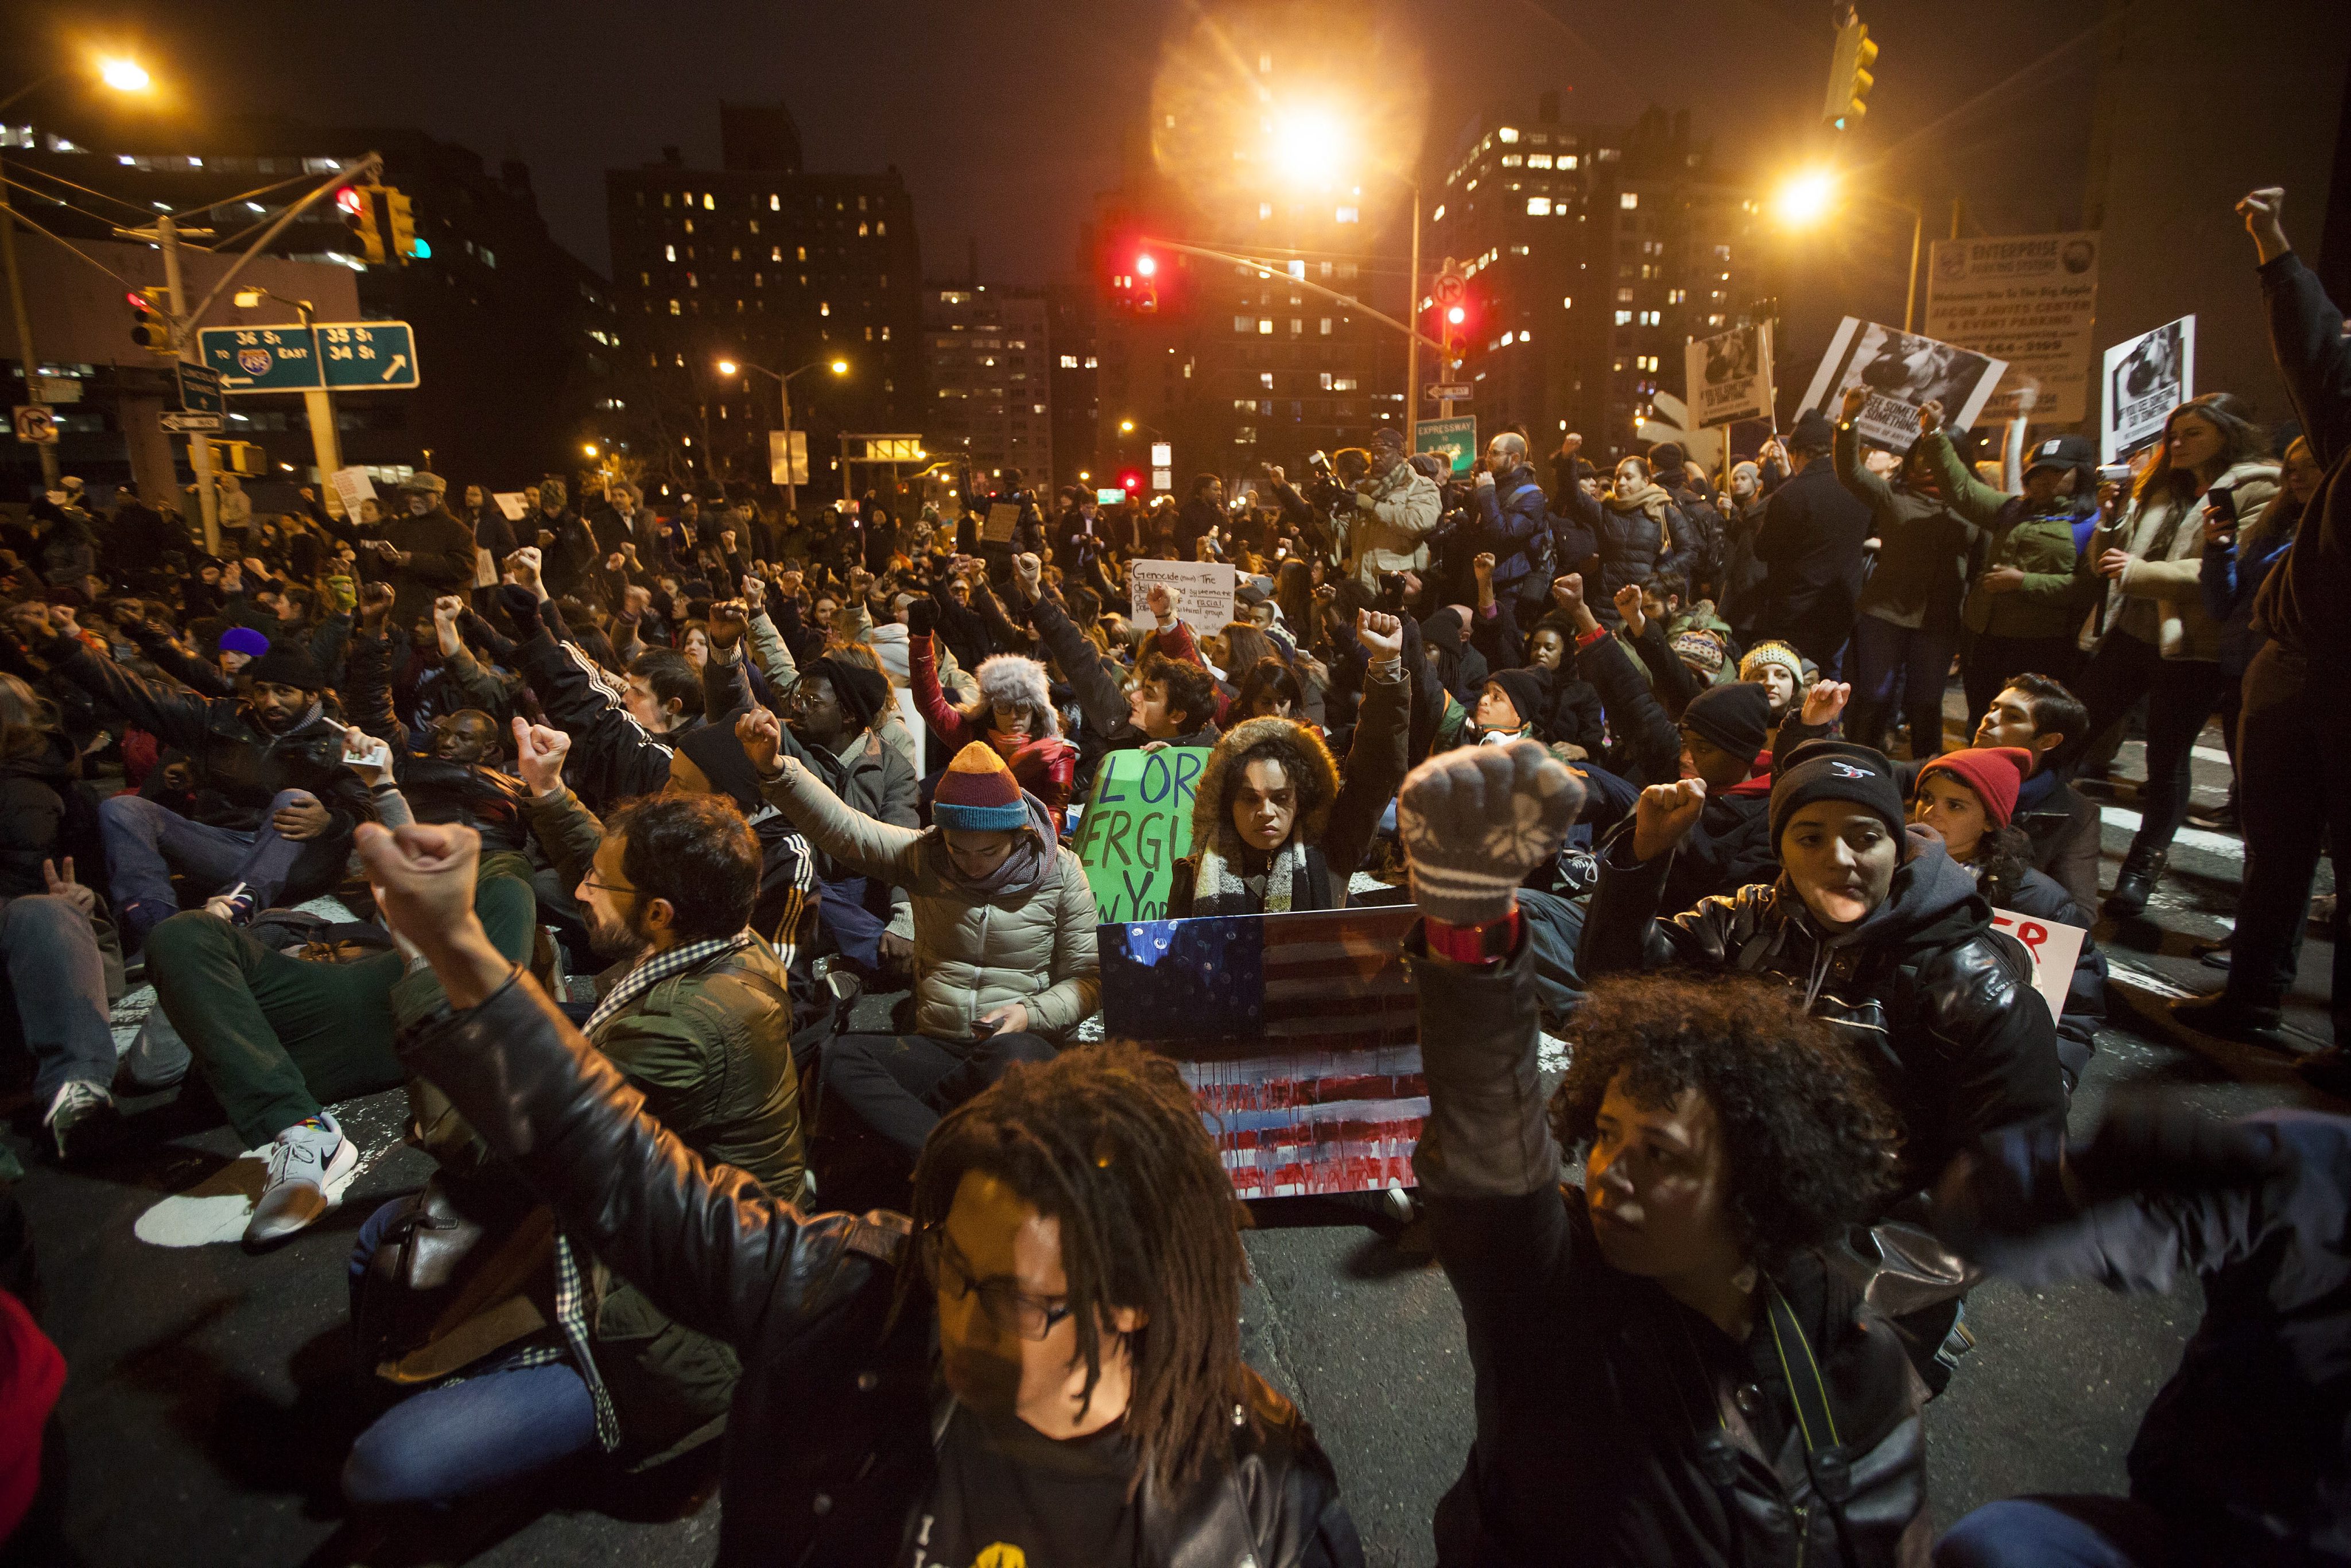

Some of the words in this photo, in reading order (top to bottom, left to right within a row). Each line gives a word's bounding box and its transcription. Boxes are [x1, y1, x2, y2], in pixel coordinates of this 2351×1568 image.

[1932, 306, 1978, 319] JACOB
[1982, 303, 2031, 316] JAVITS
[236, 331, 258, 346] 36
[263, 331, 282, 344] St
[327, 328, 350, 343] 35
[355, 328, 374, 343] St
[276, 347, 308, 359] EAST
[329, 345, 354, 361] 34
[358, 344, 377, 360] St
[1886, 400, 1921, 420] SOMETH
[1418, 422, 1471, 435] EXPRESSWAY
[1133, 563, 1179, 580] Genocide
[1200, 573, 1216, 584] The
[1204, 610, 1224, 619] group
